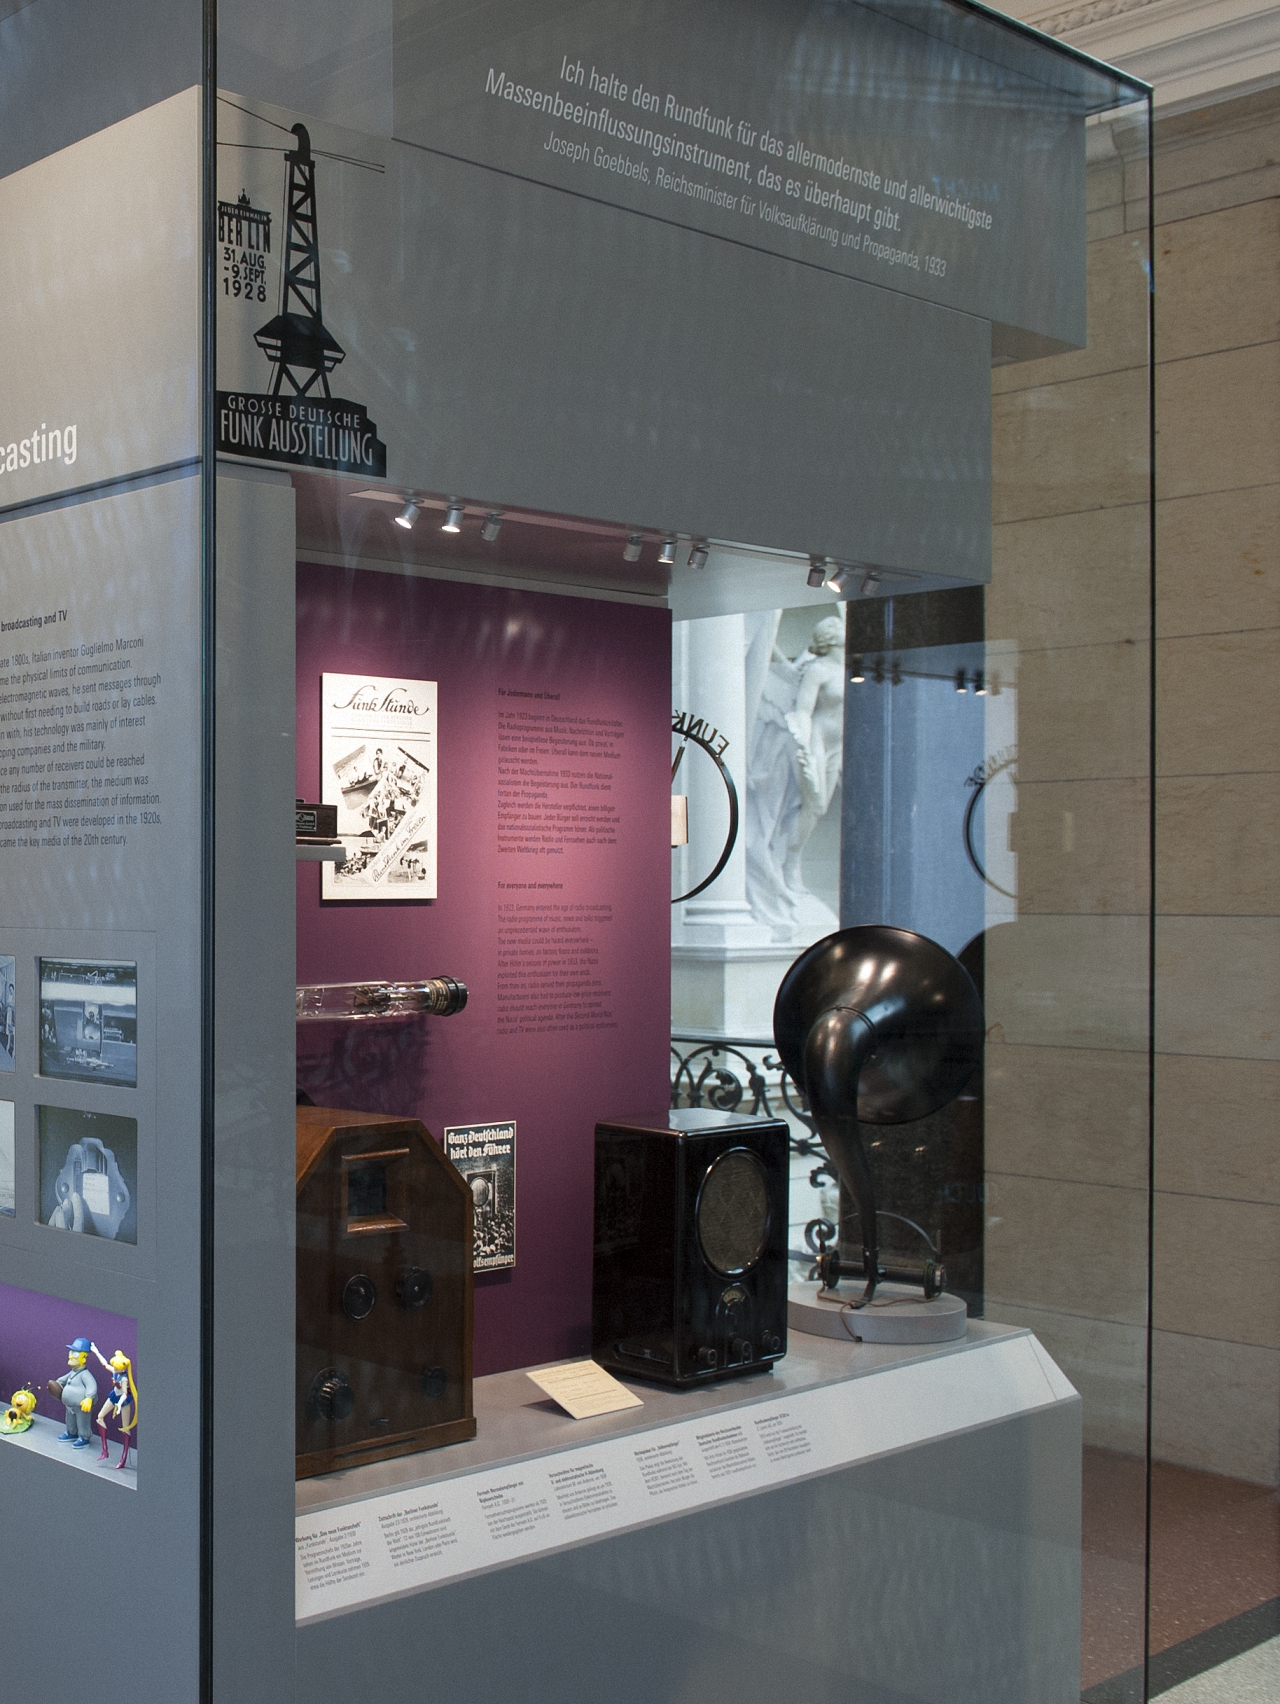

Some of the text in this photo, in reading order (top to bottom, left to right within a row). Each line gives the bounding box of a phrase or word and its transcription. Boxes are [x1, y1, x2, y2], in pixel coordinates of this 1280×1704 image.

[484, 68, 900, 232] Massenbeeinflussungsinstrument, das es überhaupt gibt.
[559, 54, 993, 230] Ich halte den Rundfunk für das allermodernste und allerwichtigste
[221, 205, 238, 214] JEDER
[543, 132, 947, 277] Joseph Goebbels, Reichsminister für Volksaufklärung und Propaganda, 1933
[218, 215, 270, 254] BERLIN
[223, 277, 267, 302] 1928
[228, 395, 360, 428] GROSSE DEUTSCHE
[221, 409, 373, 466] FUNK AUSSTELLUNG
[0, 616, 43, 632] broadcasting
[43, 611, 57, 625] and
[57, 609, 68, 622] TV
[31, 650, 52, 663] Italian
[52, 648, 79, 660] inventor
[80, 641, 114, 657] Guglielmo
[115, 637, 144, 651] Marconi
[10, 674, 21, 685] the
[22, 670, 48, 685] physical
[49, 668, 68, 679] limits
[68, 666, 76, 677] of
[77, 659, 133, 676] communication.
[47, 686, 70, 698] waves,
[71, 684, 81, 695] he
[81, 682, 97, 694] sent
[98, 678, 132, 692] messages
[133, 673, 162, 688] through
[17, 837, 28, 847] the
[28, 836, 40, 848] key
[41, 835, 61, 847] media
[62, 835, 70, 846] of
[70, 834, 82, 846] the
[83, 834, 99, 846] 20th
[100, 834, 127, 846] century.
[448, 1126, 514, 1145] Ganz Deutschland
[450, 1142, 511, 1160] hört den Führer
